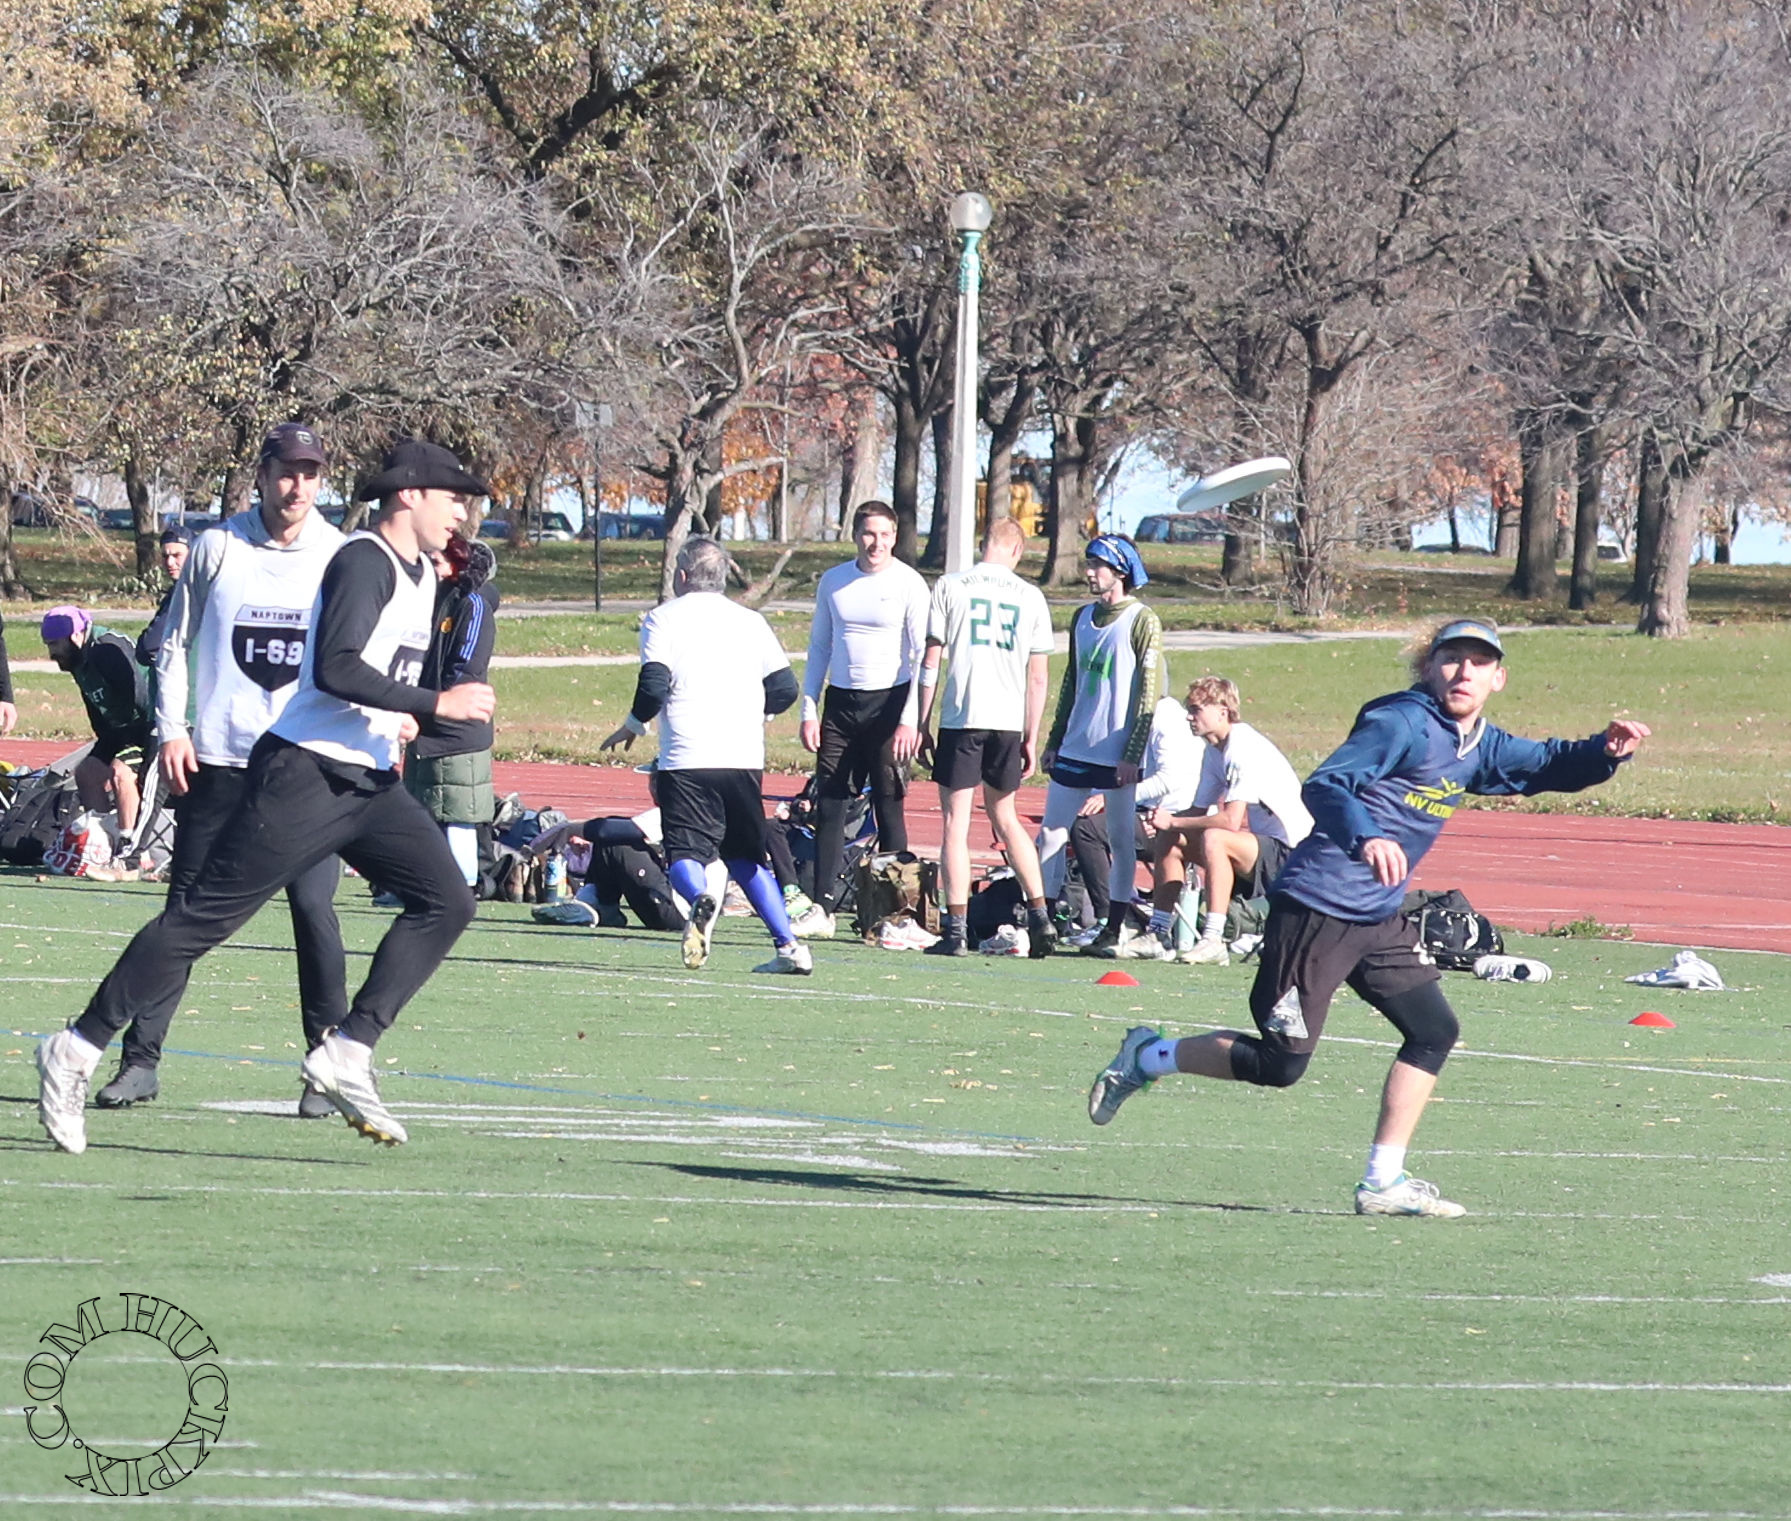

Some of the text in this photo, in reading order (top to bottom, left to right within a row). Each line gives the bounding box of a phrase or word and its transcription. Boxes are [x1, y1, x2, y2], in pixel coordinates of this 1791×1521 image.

[250, 610, 302, 622] NAPTOWN
[970, 597, 1020, 651] 23
[244, 638, 304, 666] I-69
[1404, 791, 1429, 810] NV
